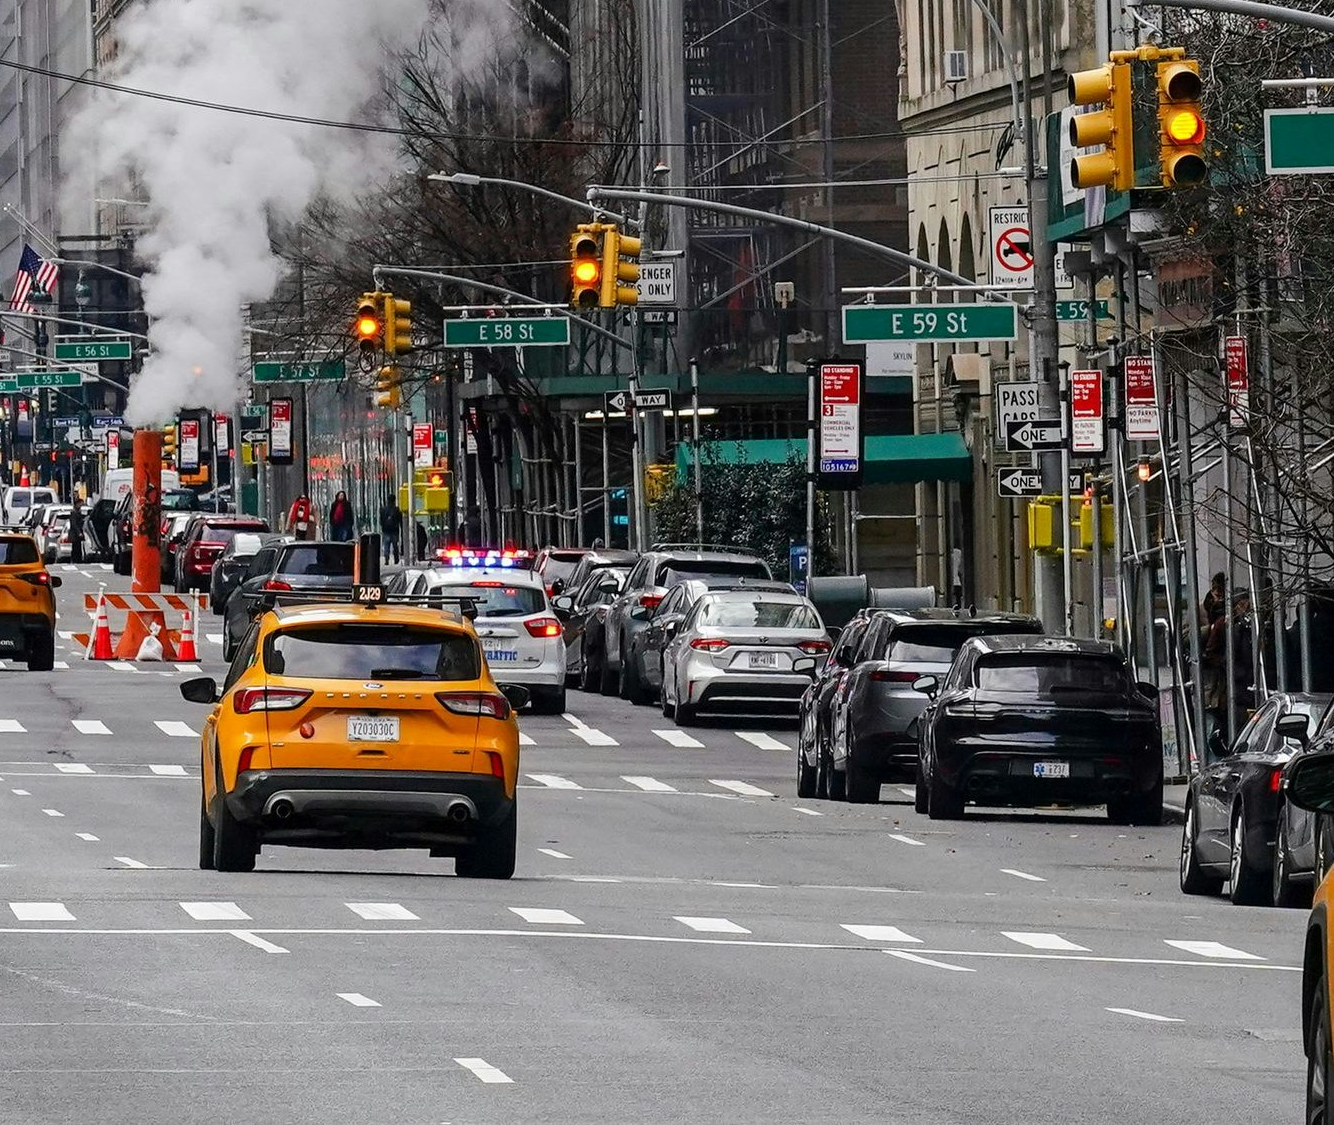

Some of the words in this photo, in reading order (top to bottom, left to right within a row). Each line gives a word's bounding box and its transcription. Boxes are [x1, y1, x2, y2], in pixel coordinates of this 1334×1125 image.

[648, 284, 671, 296] ONLY
[1069, 303, 1088, 318] 59
[892, 314, 904, 334] E
[913, 313, 937, 334] 59
[946, 312, 967, 334] St
[480, 325, 488, 340] E
[495, 325, 512, 340] 58
[519, 324, 534, 340] St
[76, 347, 81, 357] E
[84, 346, 96, 356] 56
[99, 346, 109, 356] St
[280, 367, 285, 378] E
[290, 366, 303, 377] 57
[308, 366, 320, 377] St
[0, 382, 6, 390] St
[35, 376, 39, 385] E
[42, 376, 52, 385] 55
[55, 376, 64, 384] St
[641, 395, 662, 406] WAY
[1003, 390, 1039, 407] PASS
[825, 406, 831, 415] 3
[1021, 429, 1047, 441] ONE
[1010, 477, 1036, 488] ONE
[799, 556, 807, 569] P
[359, 587, 381, 600] 2J29
[352, 722, 394, 735] Y203030C
